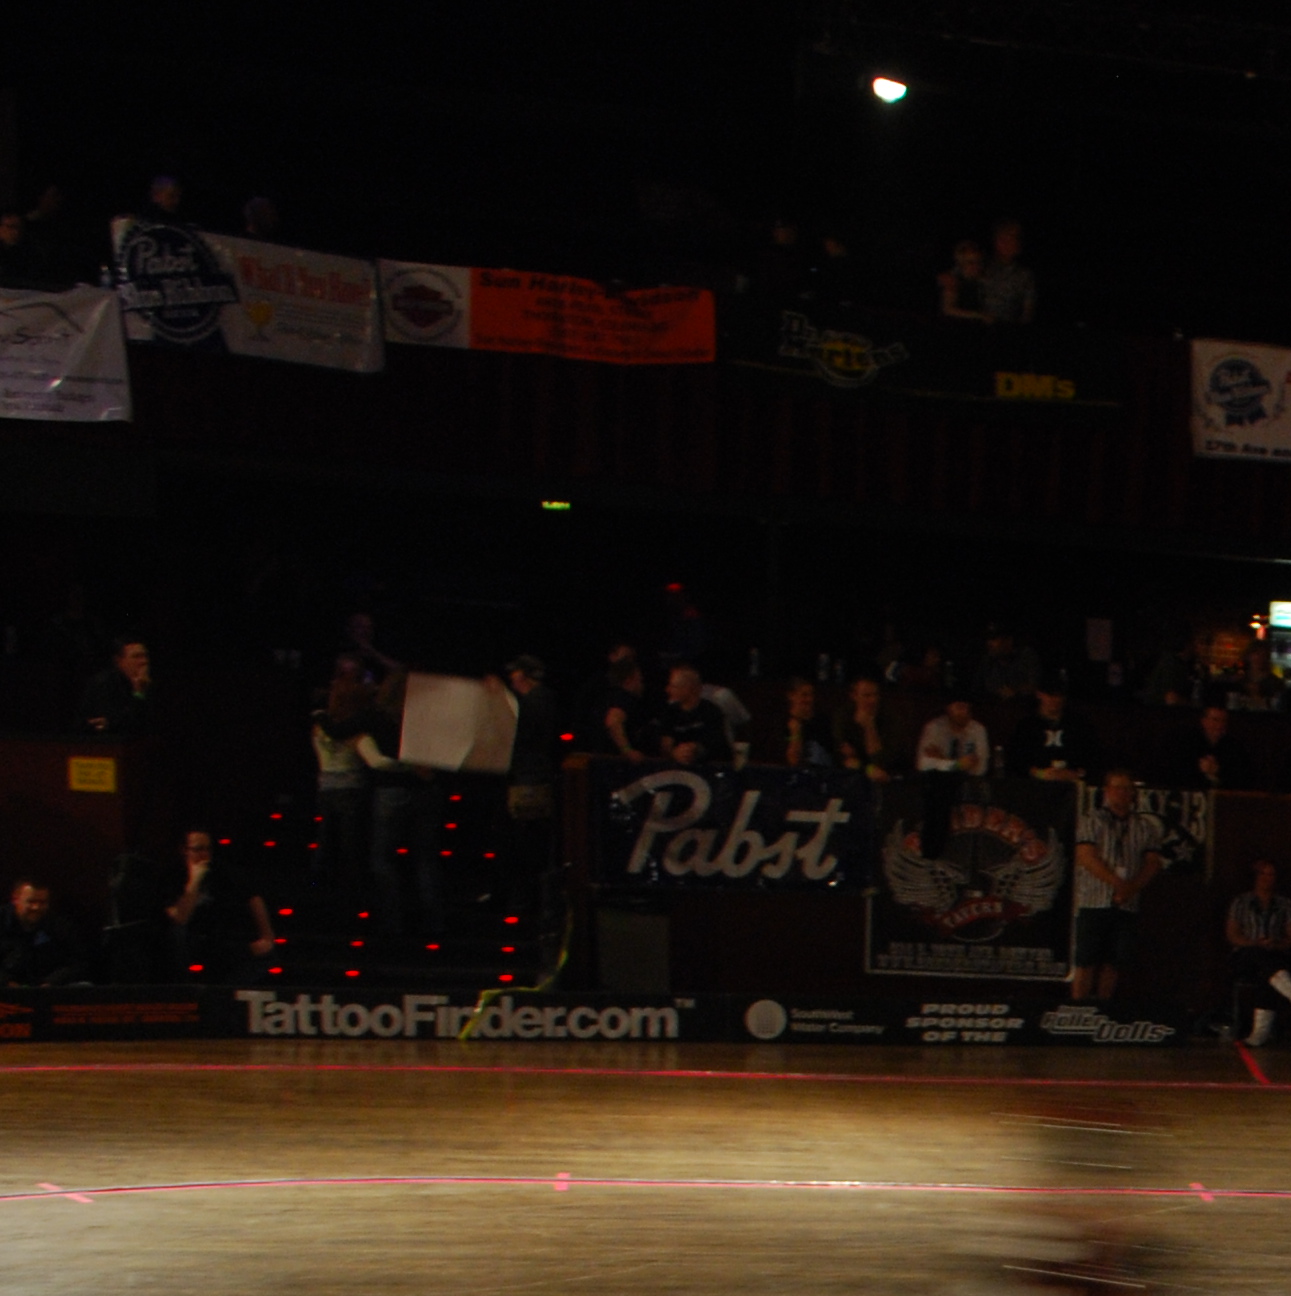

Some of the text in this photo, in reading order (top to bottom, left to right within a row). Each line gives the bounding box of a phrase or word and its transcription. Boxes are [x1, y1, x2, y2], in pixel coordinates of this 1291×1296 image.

[609, 769, 851, 880] Pabst
[234, 989, 679, 1038] TattooFinder.com
[921, 1003, 1009, 1015] PROUD
[905, 1016, 1024, 1030] SPONSOR
[1095, 1020, 1164, 1043] Dolls
[922, 1030, 1007, 1043] OF THE
